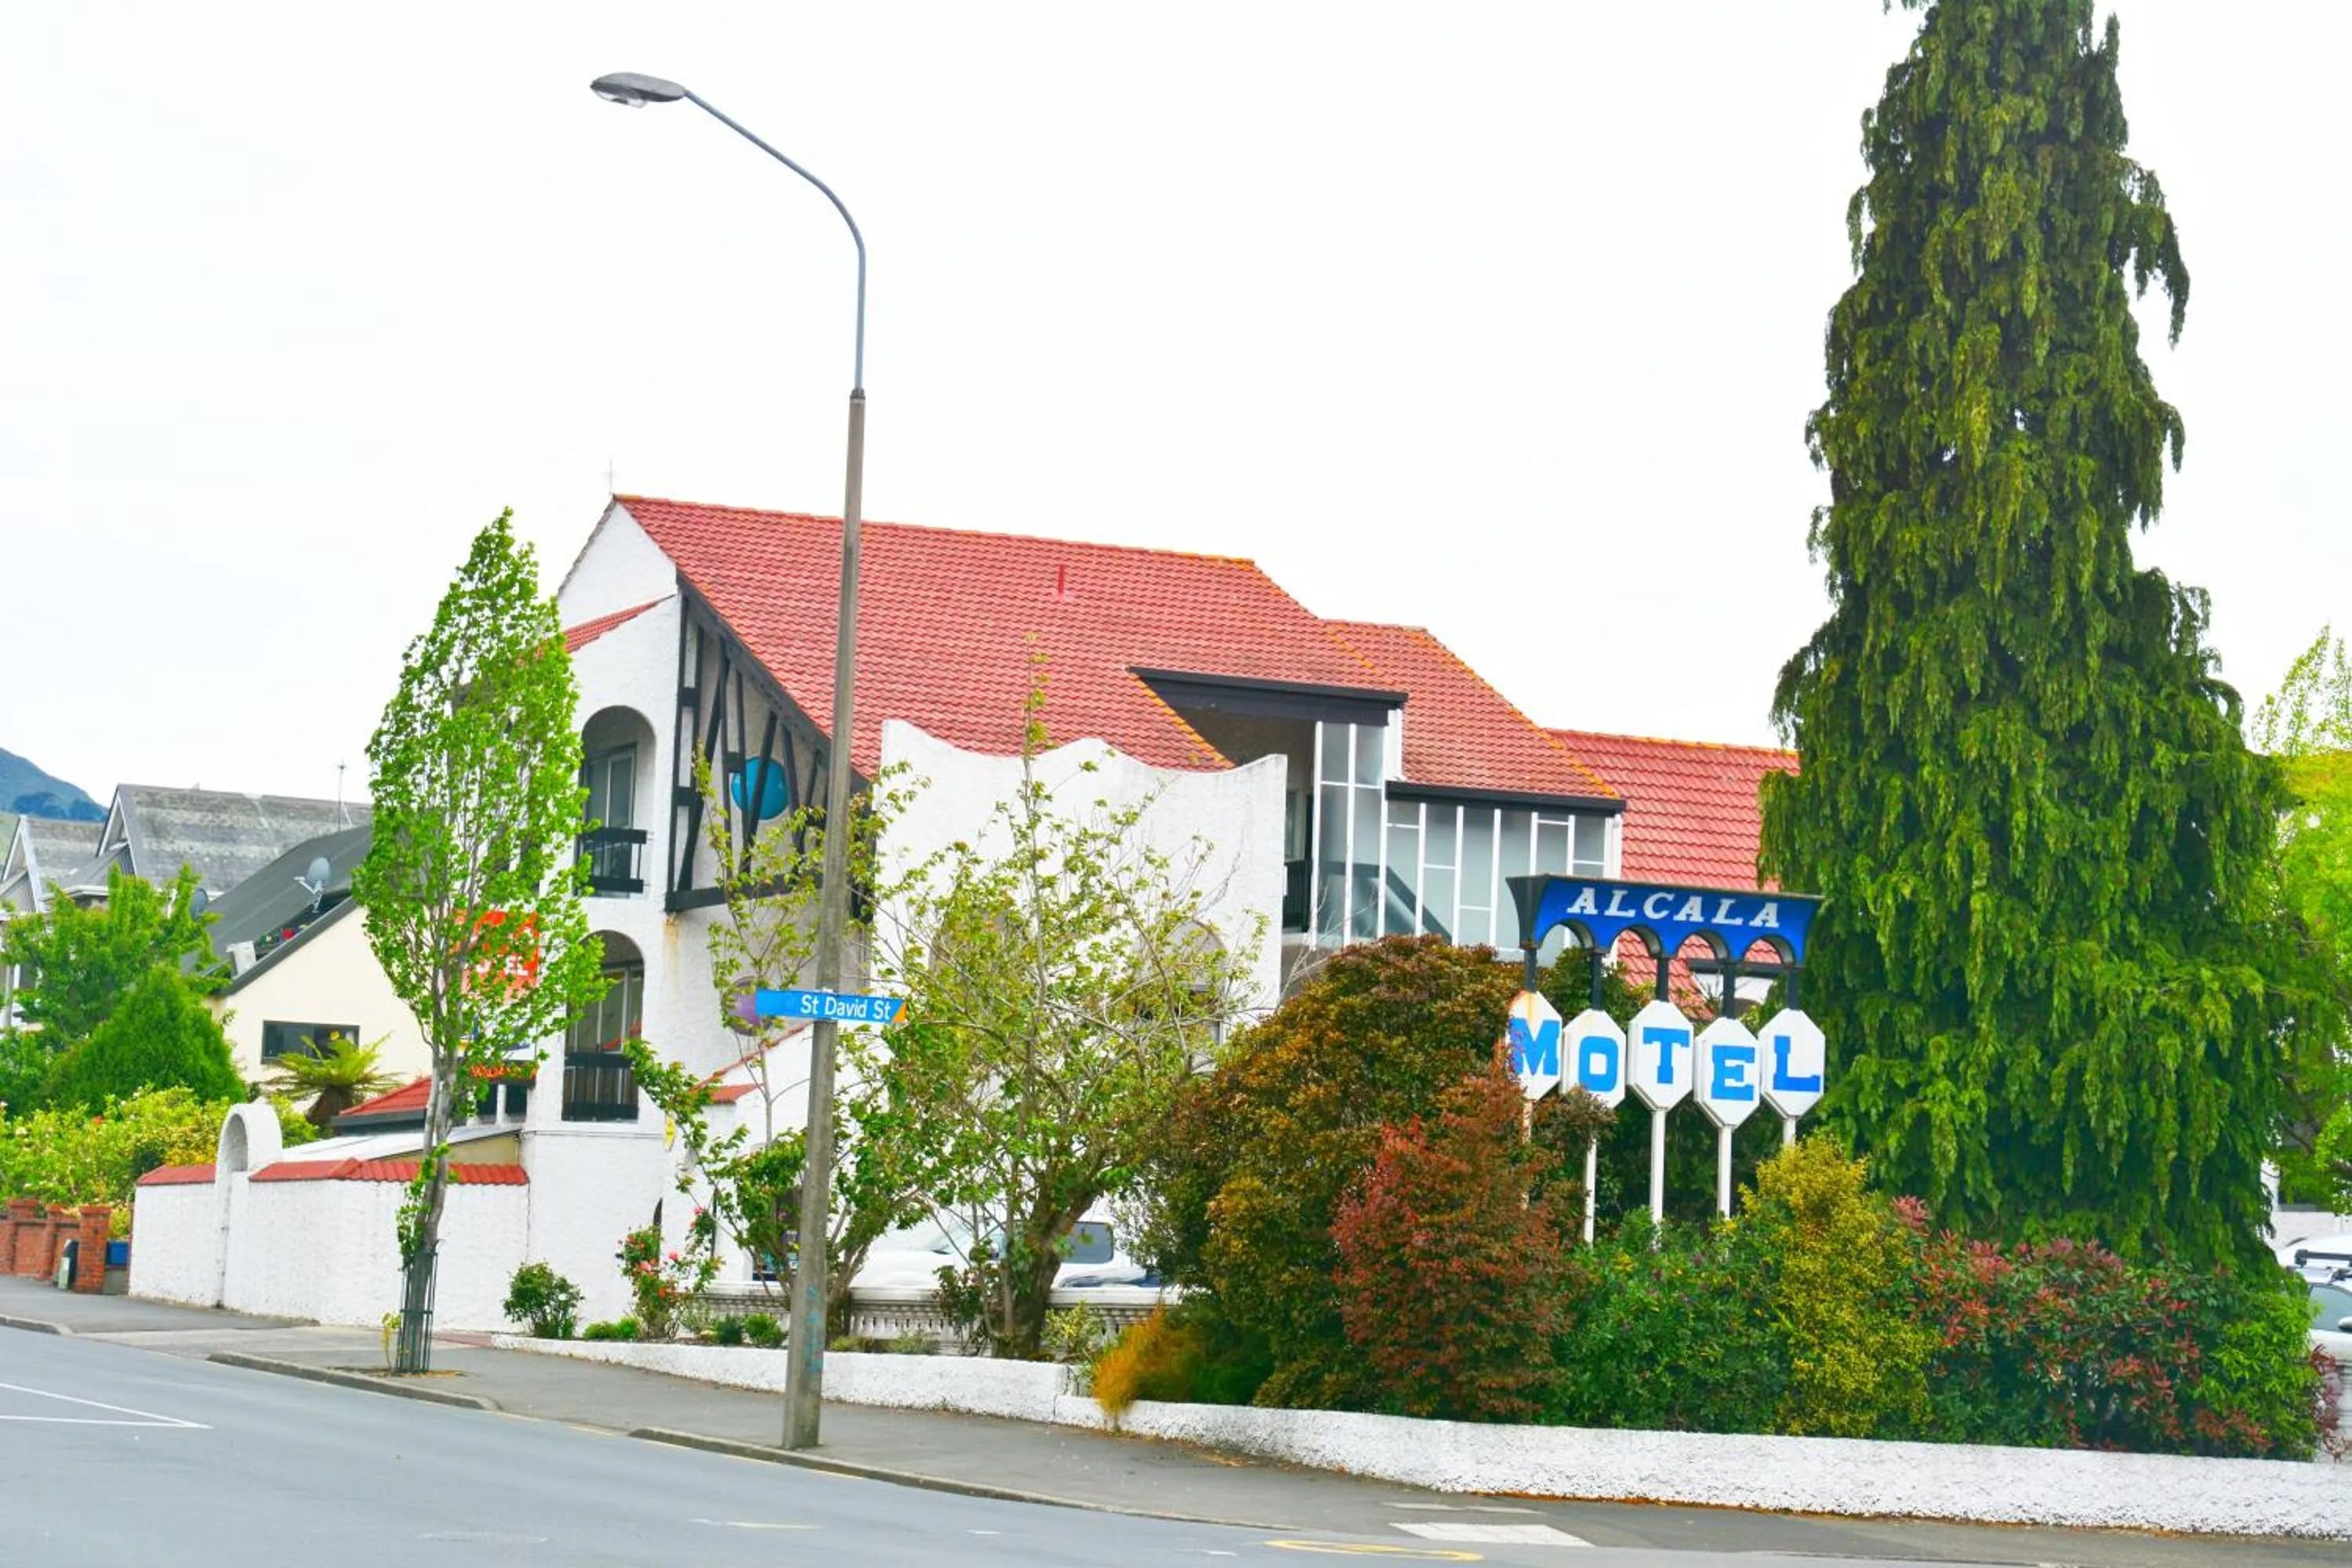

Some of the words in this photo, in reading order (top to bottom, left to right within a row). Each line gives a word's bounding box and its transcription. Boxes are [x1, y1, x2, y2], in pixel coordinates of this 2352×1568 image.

[1566, 887, 1780, 928] ALCALA
[800, 994, 819, 1014] St
[824, 996, 867, 1018] David
[872, 1000, 891, 1019] St
[1510, 1017, 1821, 1102] MOTEL
